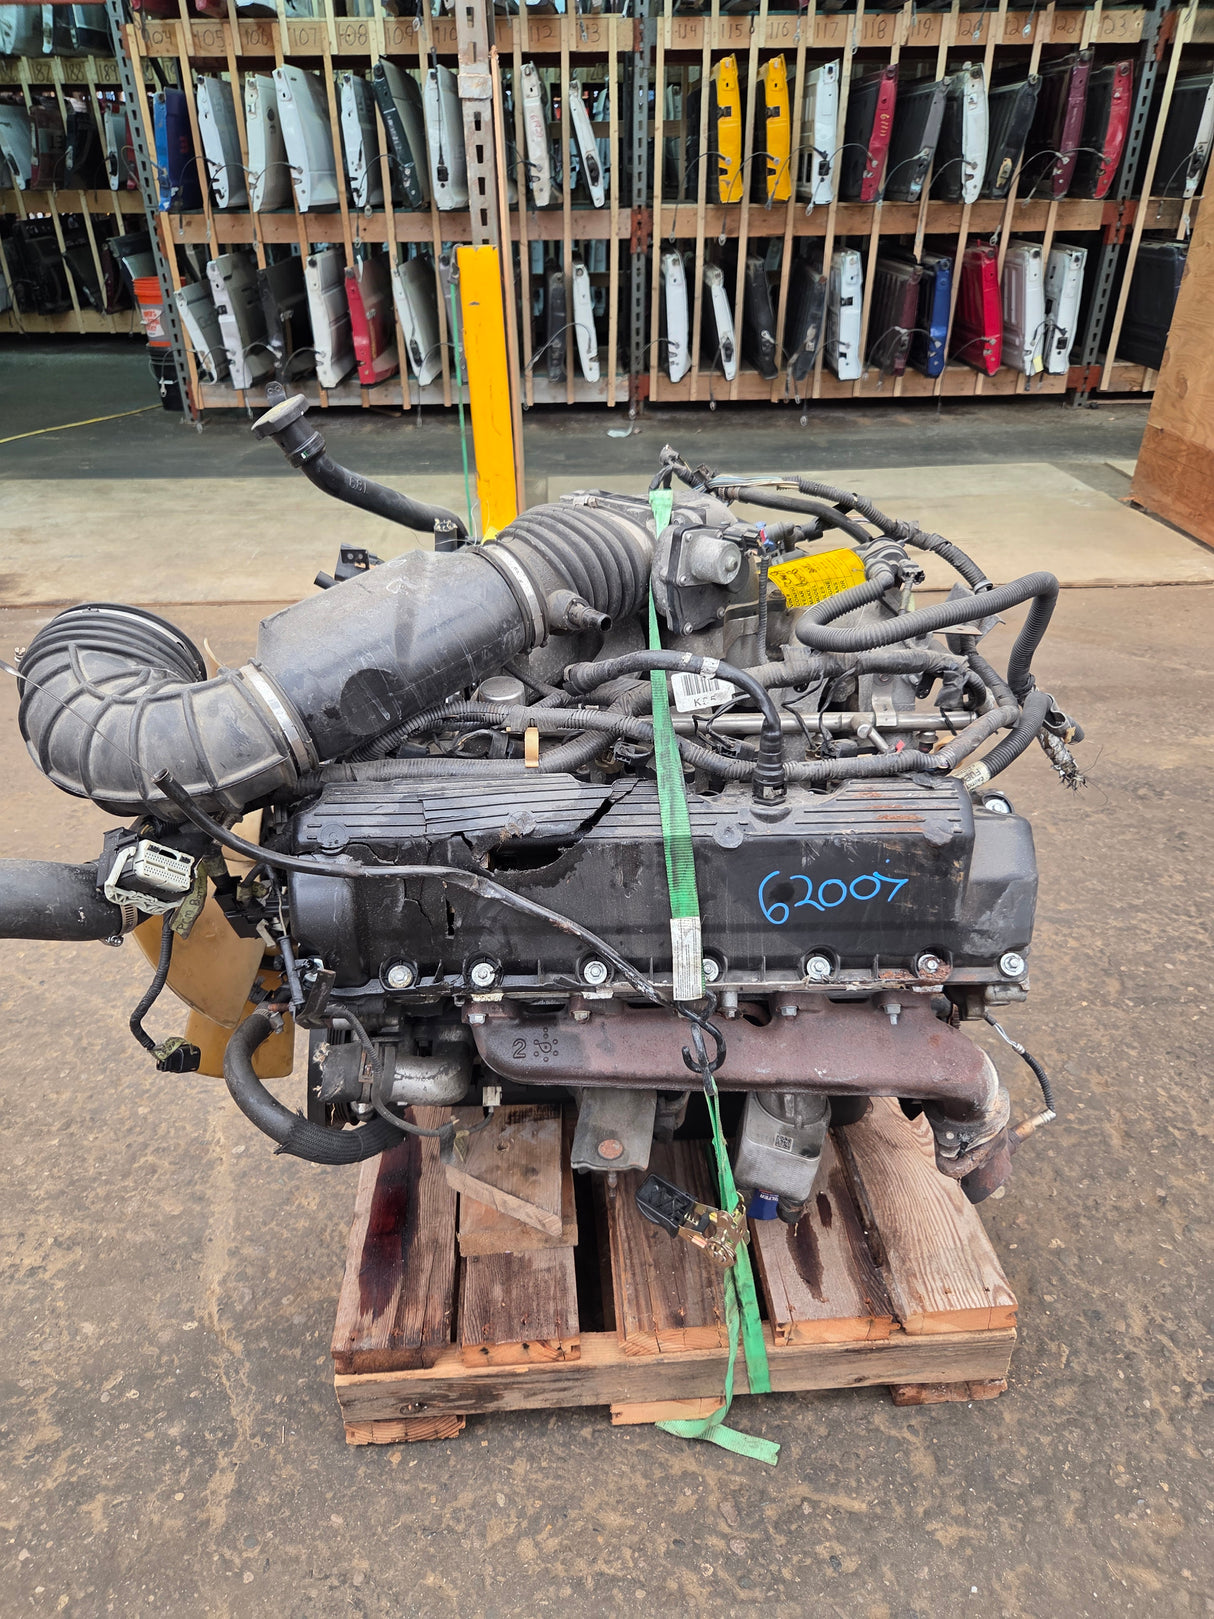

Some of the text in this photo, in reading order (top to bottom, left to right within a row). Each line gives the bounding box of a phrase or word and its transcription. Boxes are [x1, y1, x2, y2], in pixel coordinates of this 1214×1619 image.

[721, 23, 743, 39] 115
[770, 21, 789, 39] 116
[816, 22, 839, 39] 117
[864, 19, 887, 40] 118
[758, 870, 909, 925] 62007
[512, 1038, 527, 1059] 2
